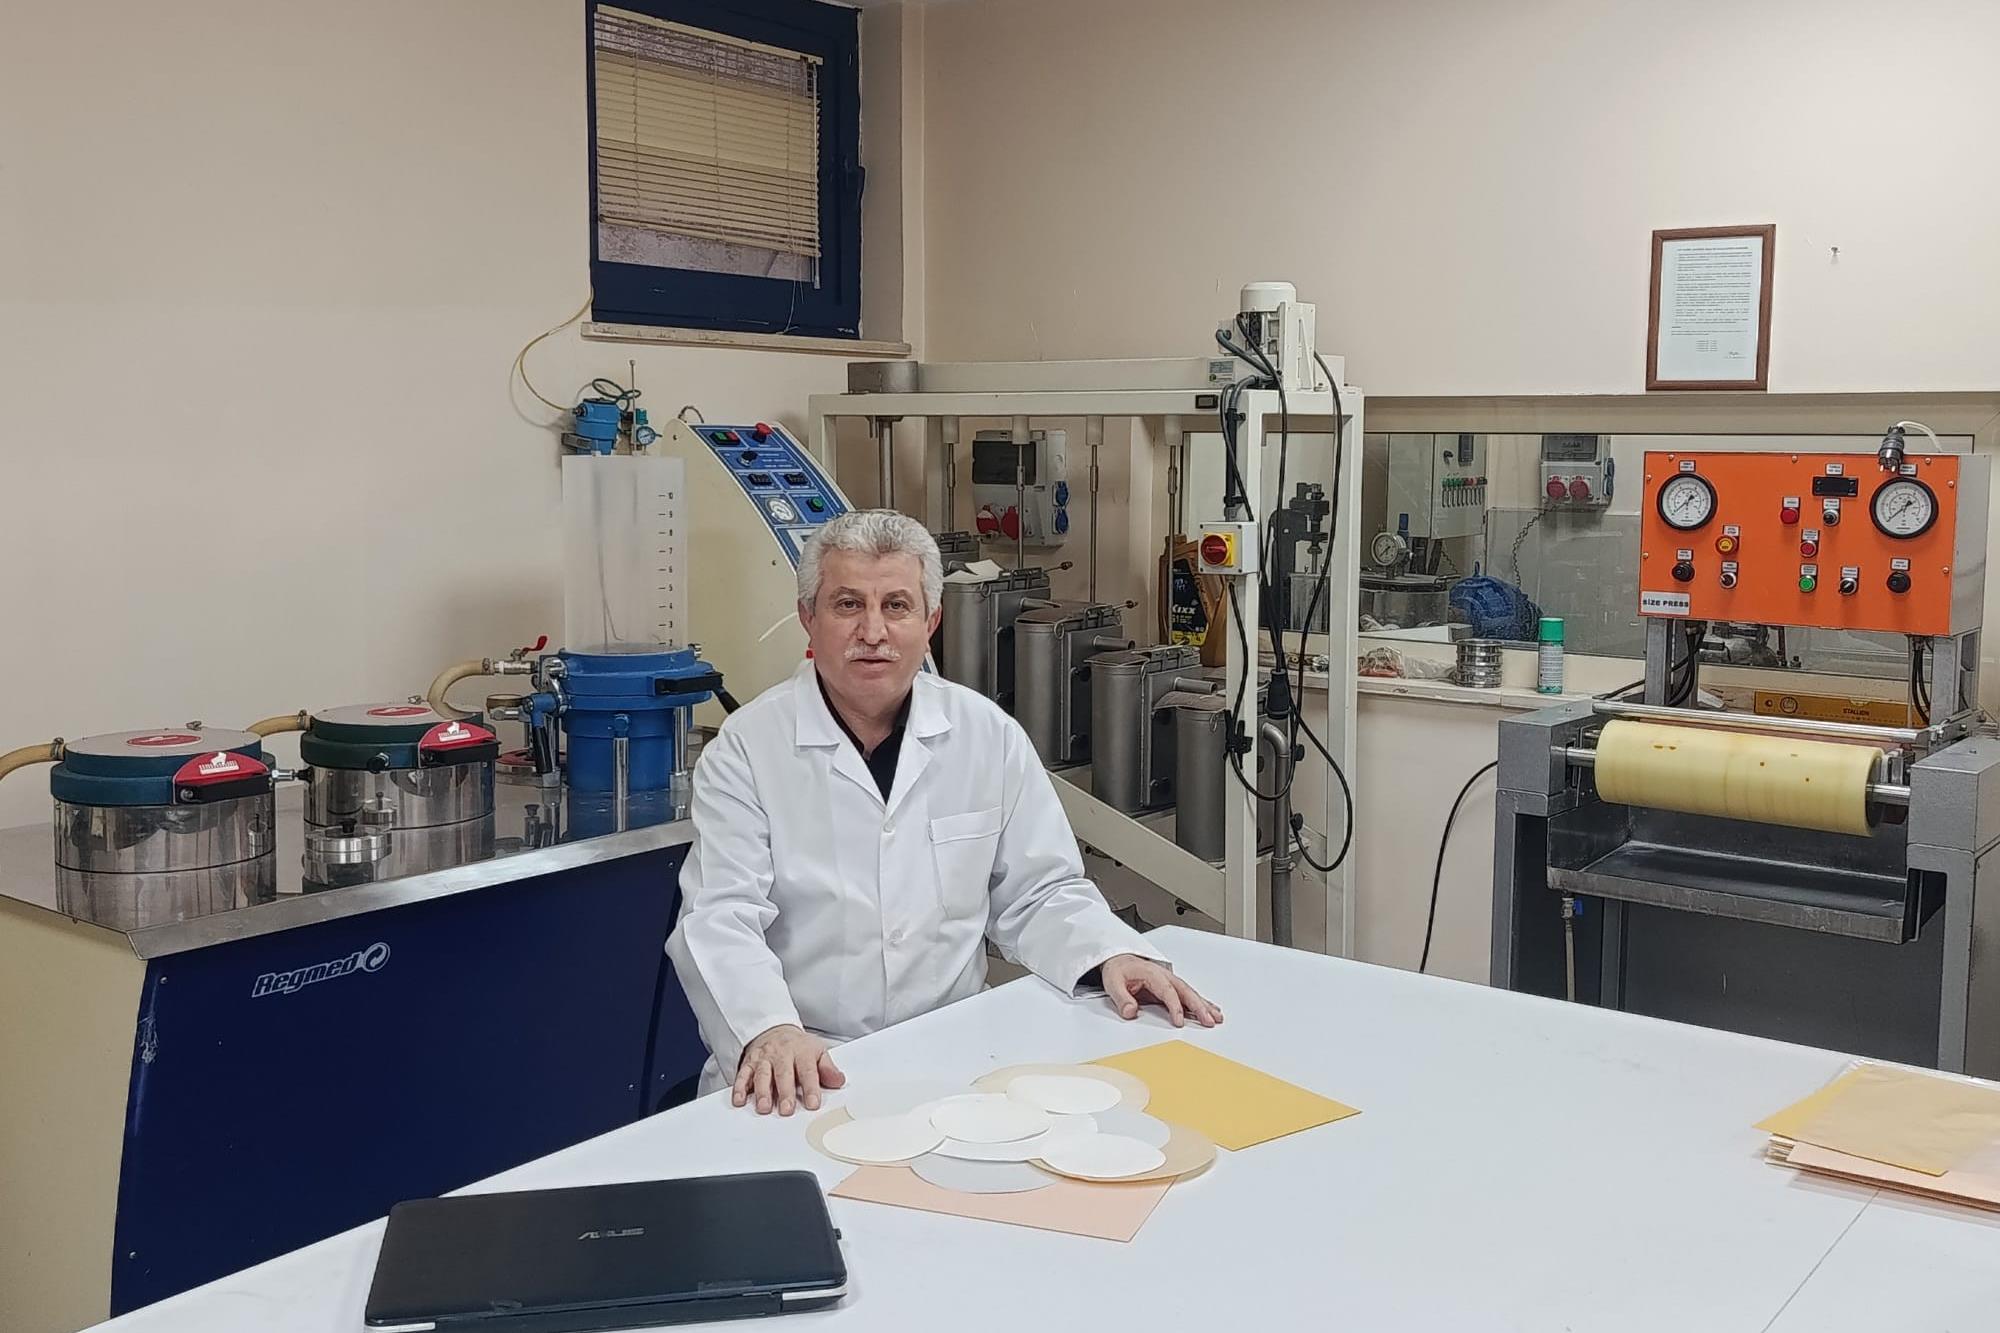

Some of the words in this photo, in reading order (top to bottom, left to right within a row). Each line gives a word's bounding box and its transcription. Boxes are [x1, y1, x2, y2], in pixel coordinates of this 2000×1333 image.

[1663, 600, 1689, 608] PRESS
[251, 951, 364, 998] Regmed
[577, 1227, 645, 1240] ASUS
